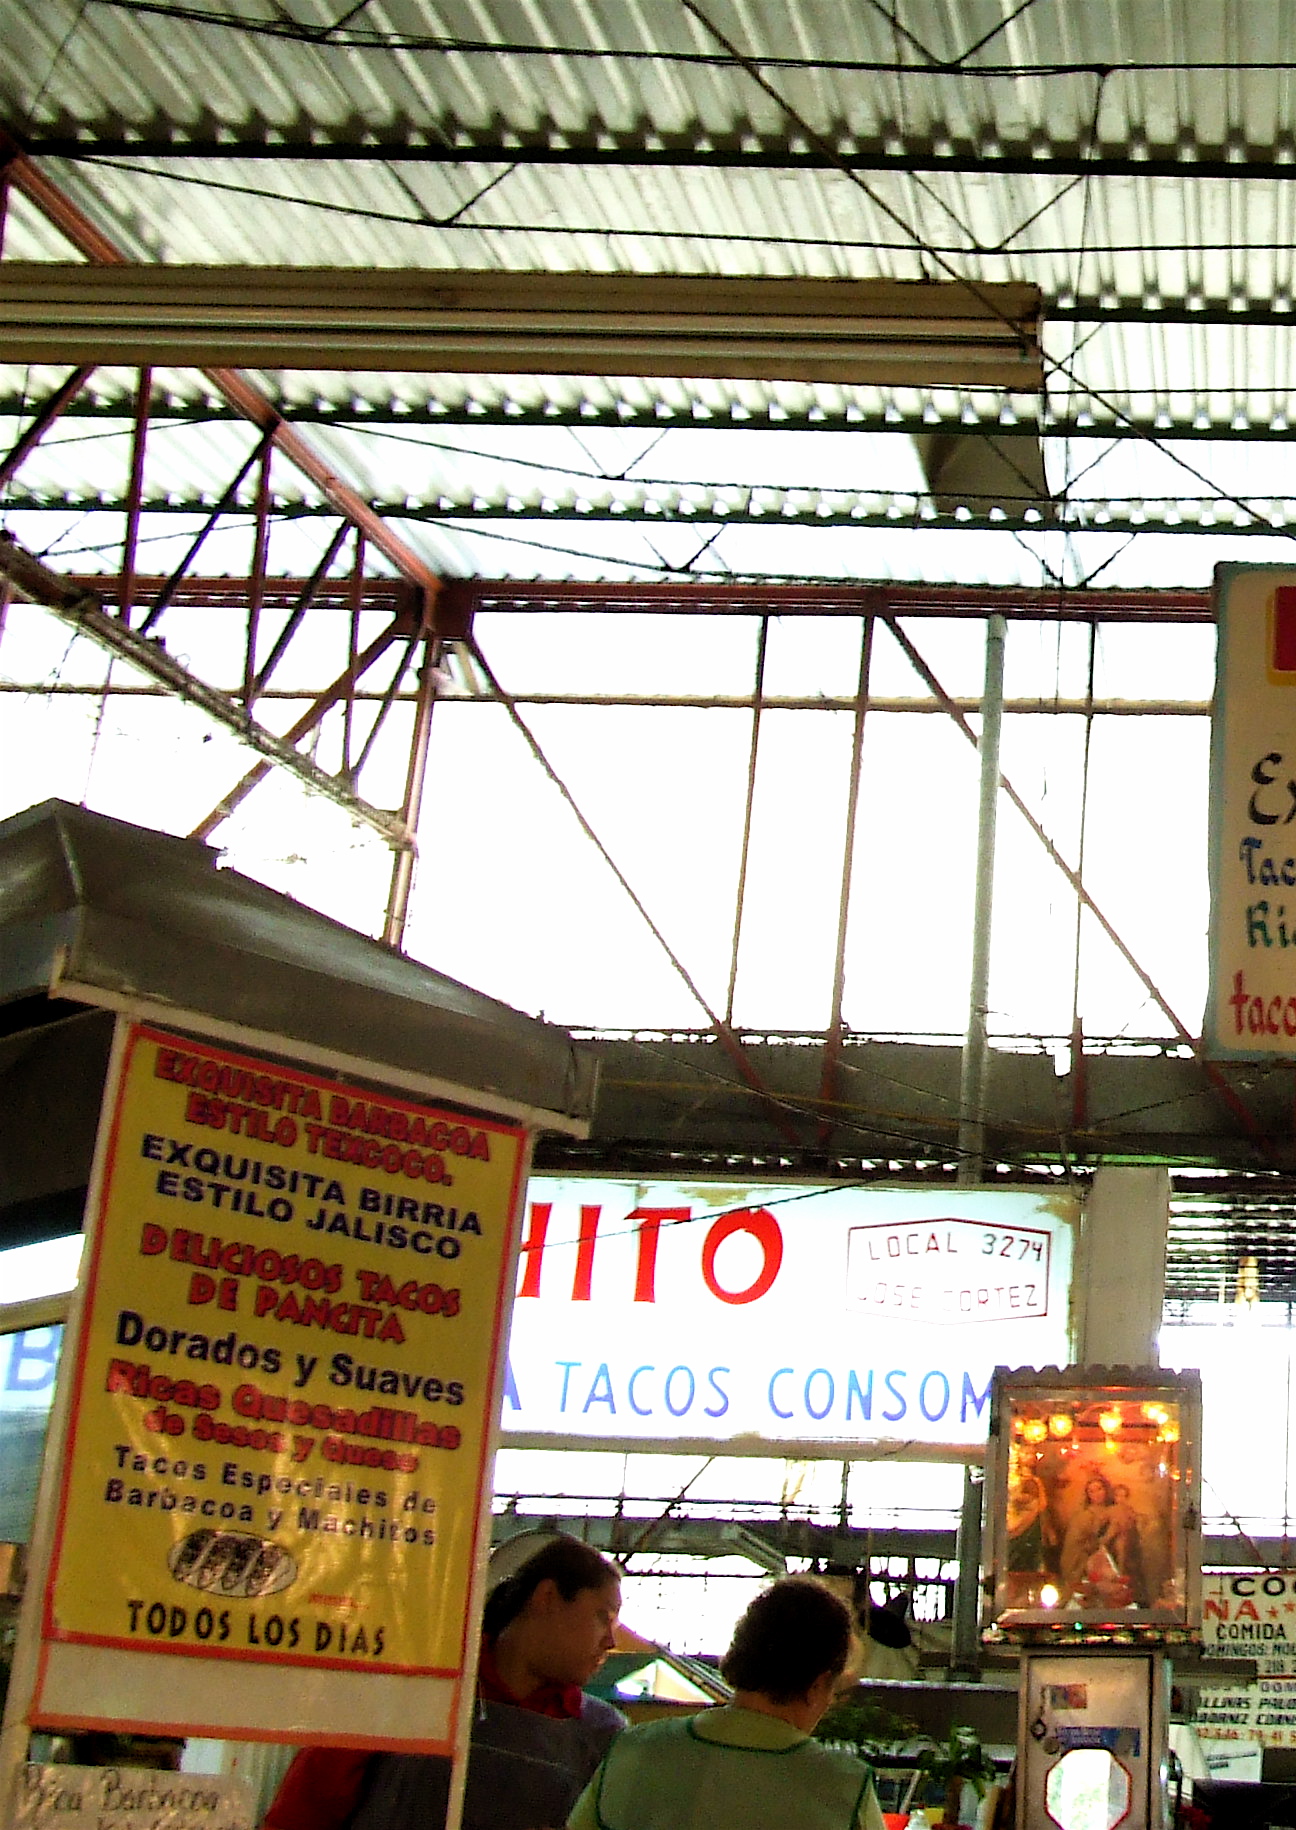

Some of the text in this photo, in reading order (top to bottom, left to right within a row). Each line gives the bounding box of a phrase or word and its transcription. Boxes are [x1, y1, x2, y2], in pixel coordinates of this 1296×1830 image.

[155, 1047, 491, 1163] EXQUISITA BARBACOA
[185, 1091, 454, 1187] ESTILO TEXCOCO.
[141, 1132, 484, 1237] EXQUISITA BIRRIA
[155, 1169, 462, 1260] ESTILO JALISCO
[139, 1222, 462, 1317] DELICIOSOS TACOS
[868, 1232, 1044, 1262] LOCAL 3274
[187, 1271, 407, 1345] DE PANCITA
[857, 1282, 923, 1309] OSE
[115, 1309, 283, 1375] Dorados
[294, 1352, 319, 1388] y
[328, 1352, 466, 1407] Suaves
[555, 1360, 731, 1418] TACOS
[104, 1357, 222, 1412] Ricas
[230, 1383, 463, 1451] Quesadillas
[143, 1404, 420, 1474] de Sesos y Queso
[103, 1477, 438, 1547] Barbacoa y Machitos
[113, 1444, 438, 1515] Tacos Especiales de
[126, 1600, 387, 1657] TODOS LOS DIAS
[1216, 1623, 1288, 1641] COMIDA
